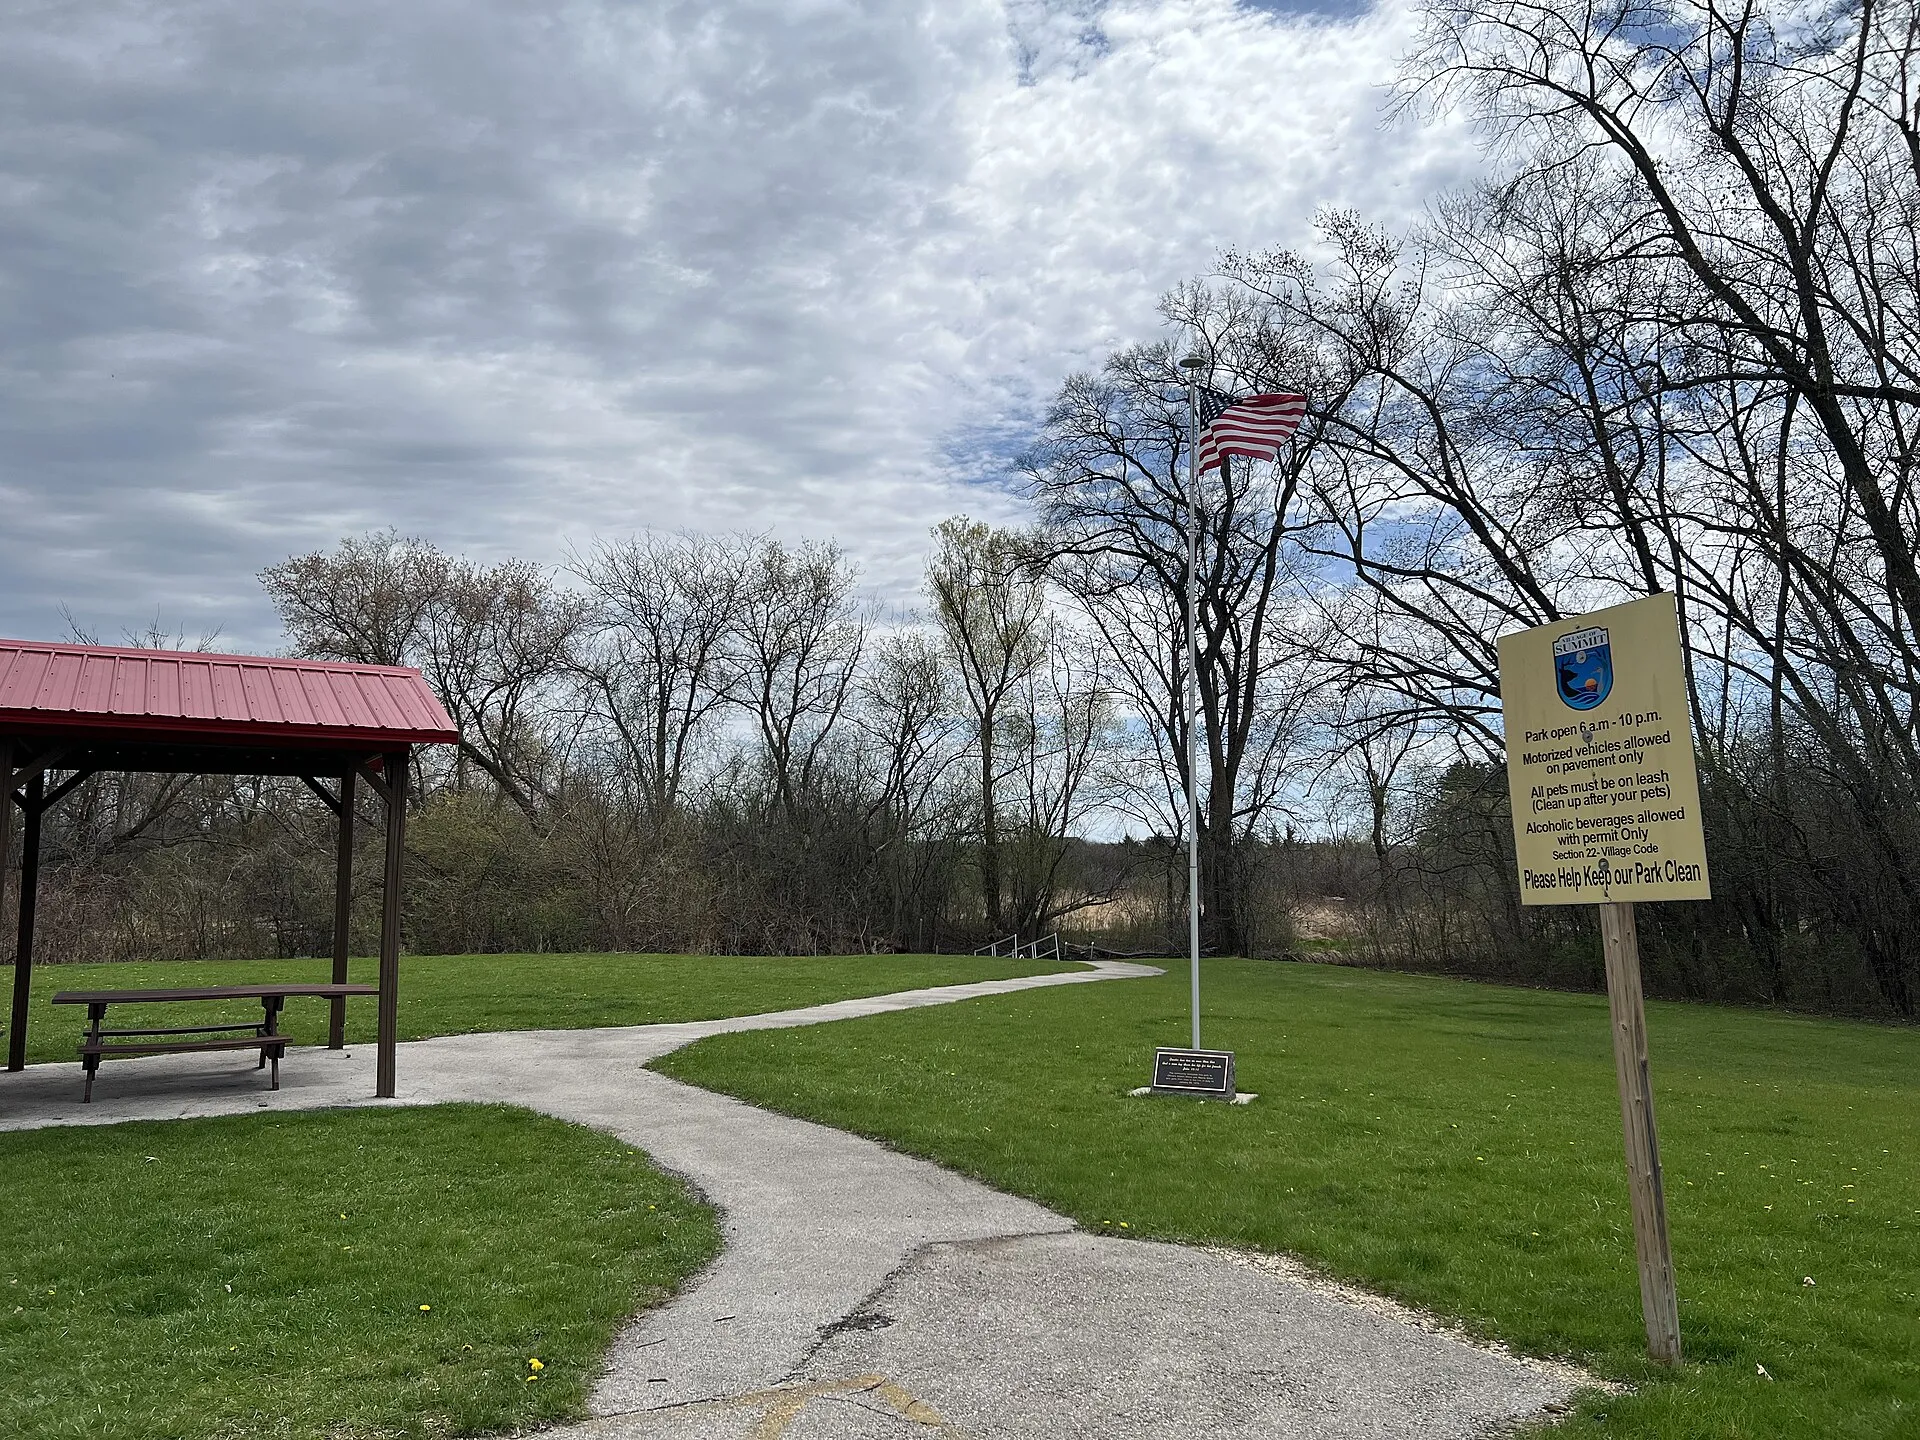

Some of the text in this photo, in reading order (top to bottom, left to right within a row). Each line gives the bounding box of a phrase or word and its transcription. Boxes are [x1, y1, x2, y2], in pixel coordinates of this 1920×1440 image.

[1555, 634, 1606, 653] SUMMIT
[1562, 634, 1587, 642] VILLAGE
[1525, 729, 1548, 743] Park
[1551, 725, 1577, 741] open
[1580, 722, 1586, 733] 6
[1589, 720, 1609, 732] a.m
[1619, 713, 1632, 726] 10
[1636, 711, 1662, 727] p.m.
[1523, 731, 1670, 765] Motorized vehicles allowed
[1547, 750, 1643, 775] on pavement only
[1531, 770, 1669, 799] All pets must be on leash
[1533, 784, 1670, 814] (Clean up after your pets)
[1526, 807, 1685, 834] Alcoholic beverages allowed
[1558, 827, 1648, 846] with permit Only
[1553, 849, 1584, 860] Section
[1601, 846, 1631, 858] Village
[1633, 843, 1658, 854] Code
[1524, 860, 1701, 892] Please Help Keep our Park Clean
